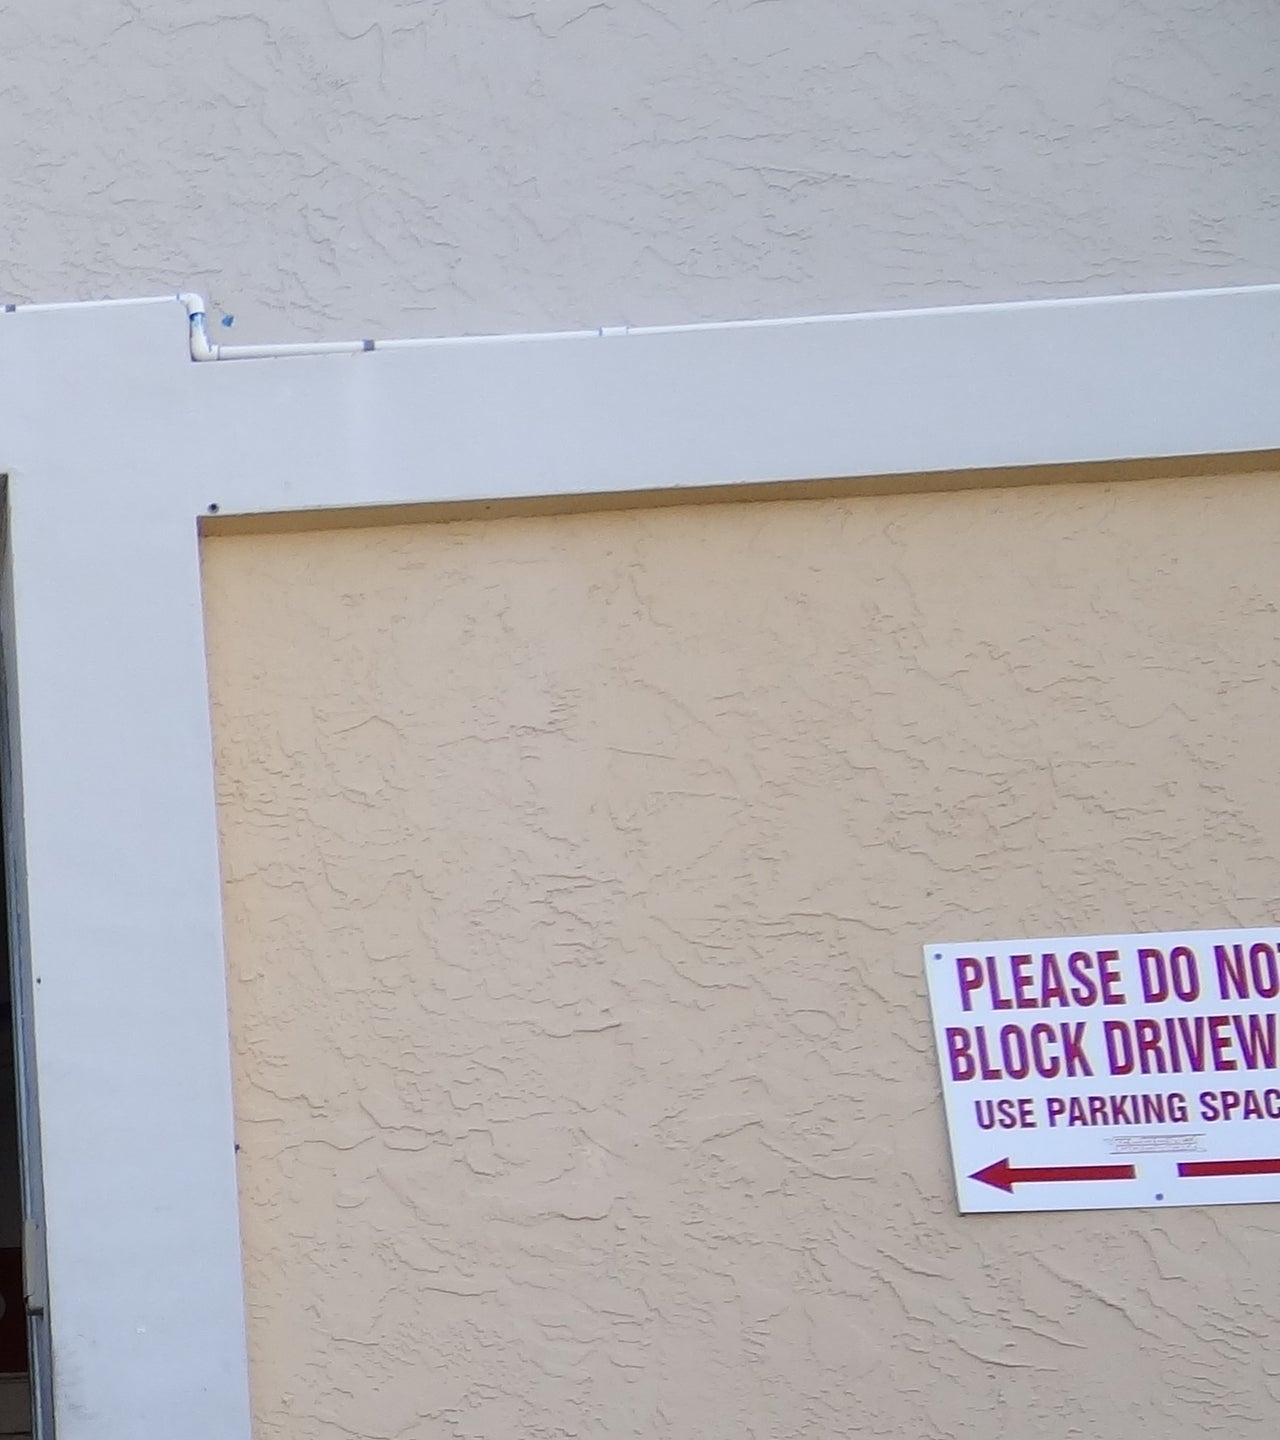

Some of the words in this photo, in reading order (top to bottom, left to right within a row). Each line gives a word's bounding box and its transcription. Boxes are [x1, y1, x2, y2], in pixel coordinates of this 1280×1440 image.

[956, 949, 1127, 1012] PLEASE
[1137, 945, 1201, 1004] DO
[1213, 941, 1280, 1001] NO
[945, 1021, 1095, 1082] BLOCK
[973, 1098, 1038, 1130] USE
[1045, 1092, 1190, 1128] PARKING
